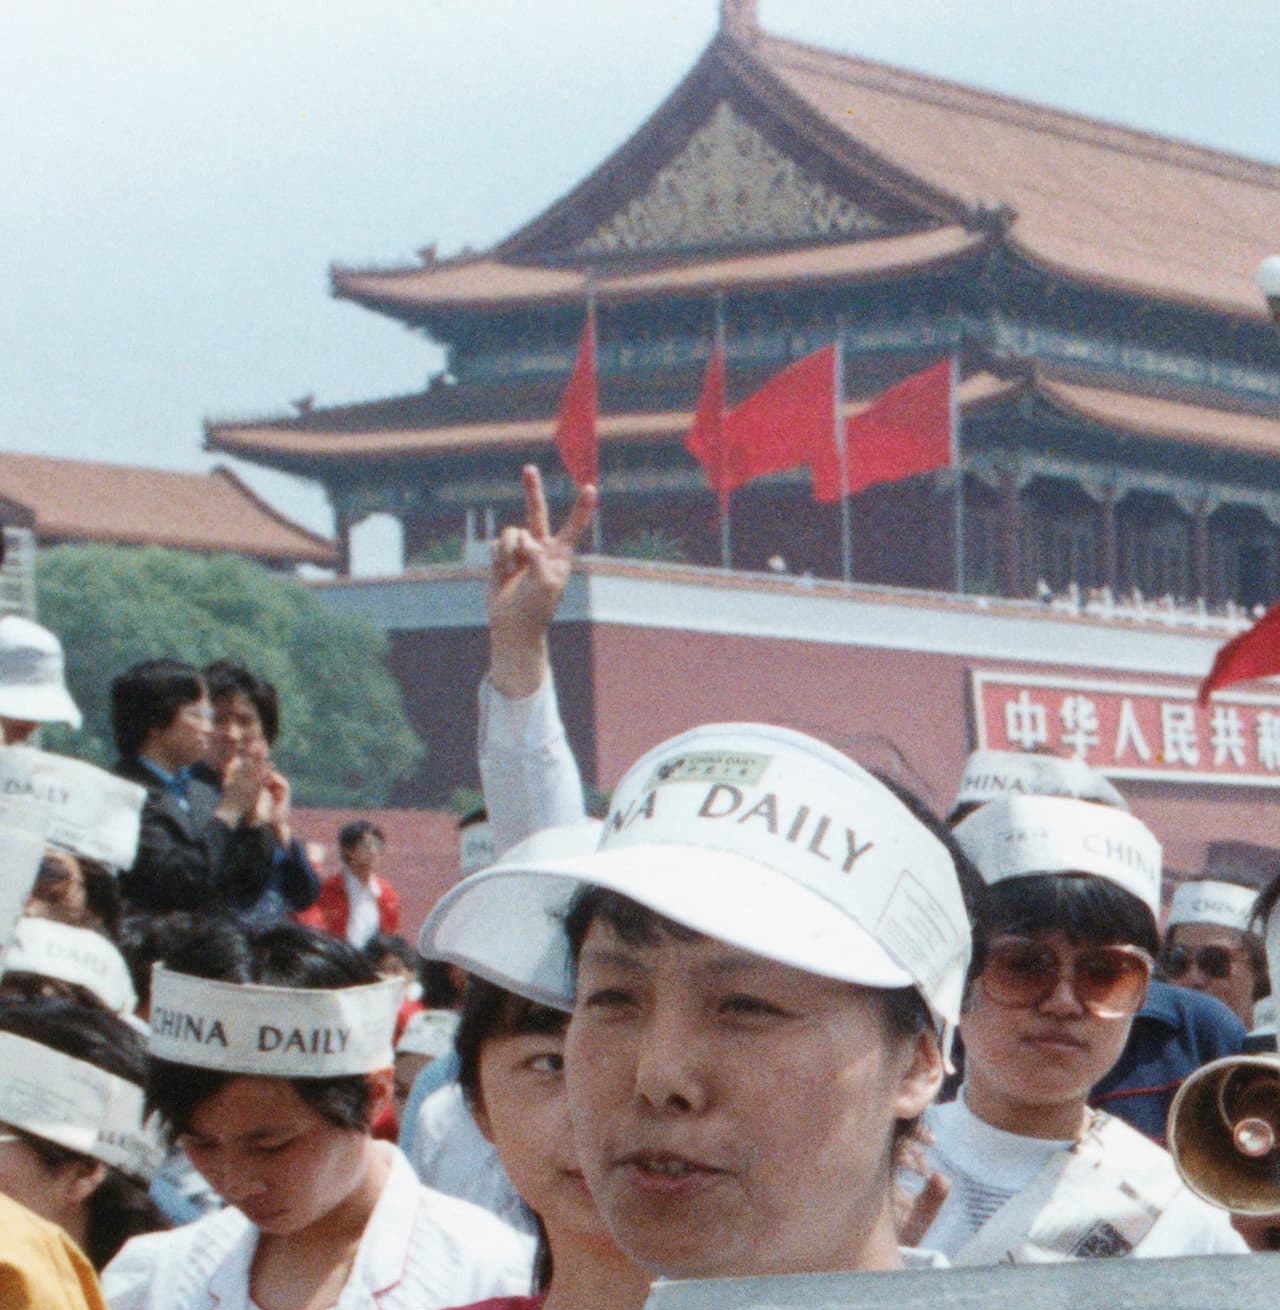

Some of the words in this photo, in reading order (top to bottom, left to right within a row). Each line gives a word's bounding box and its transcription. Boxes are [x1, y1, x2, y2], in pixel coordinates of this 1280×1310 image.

[962, 774, 1024, 792] HINA
[696, 784, 875, 874] DAILY
[1084, 833, 1157, 881] CHIN
[153, 1006, 229, 1047] CHINA
[257, 1024, 350, 1054] DAILY
